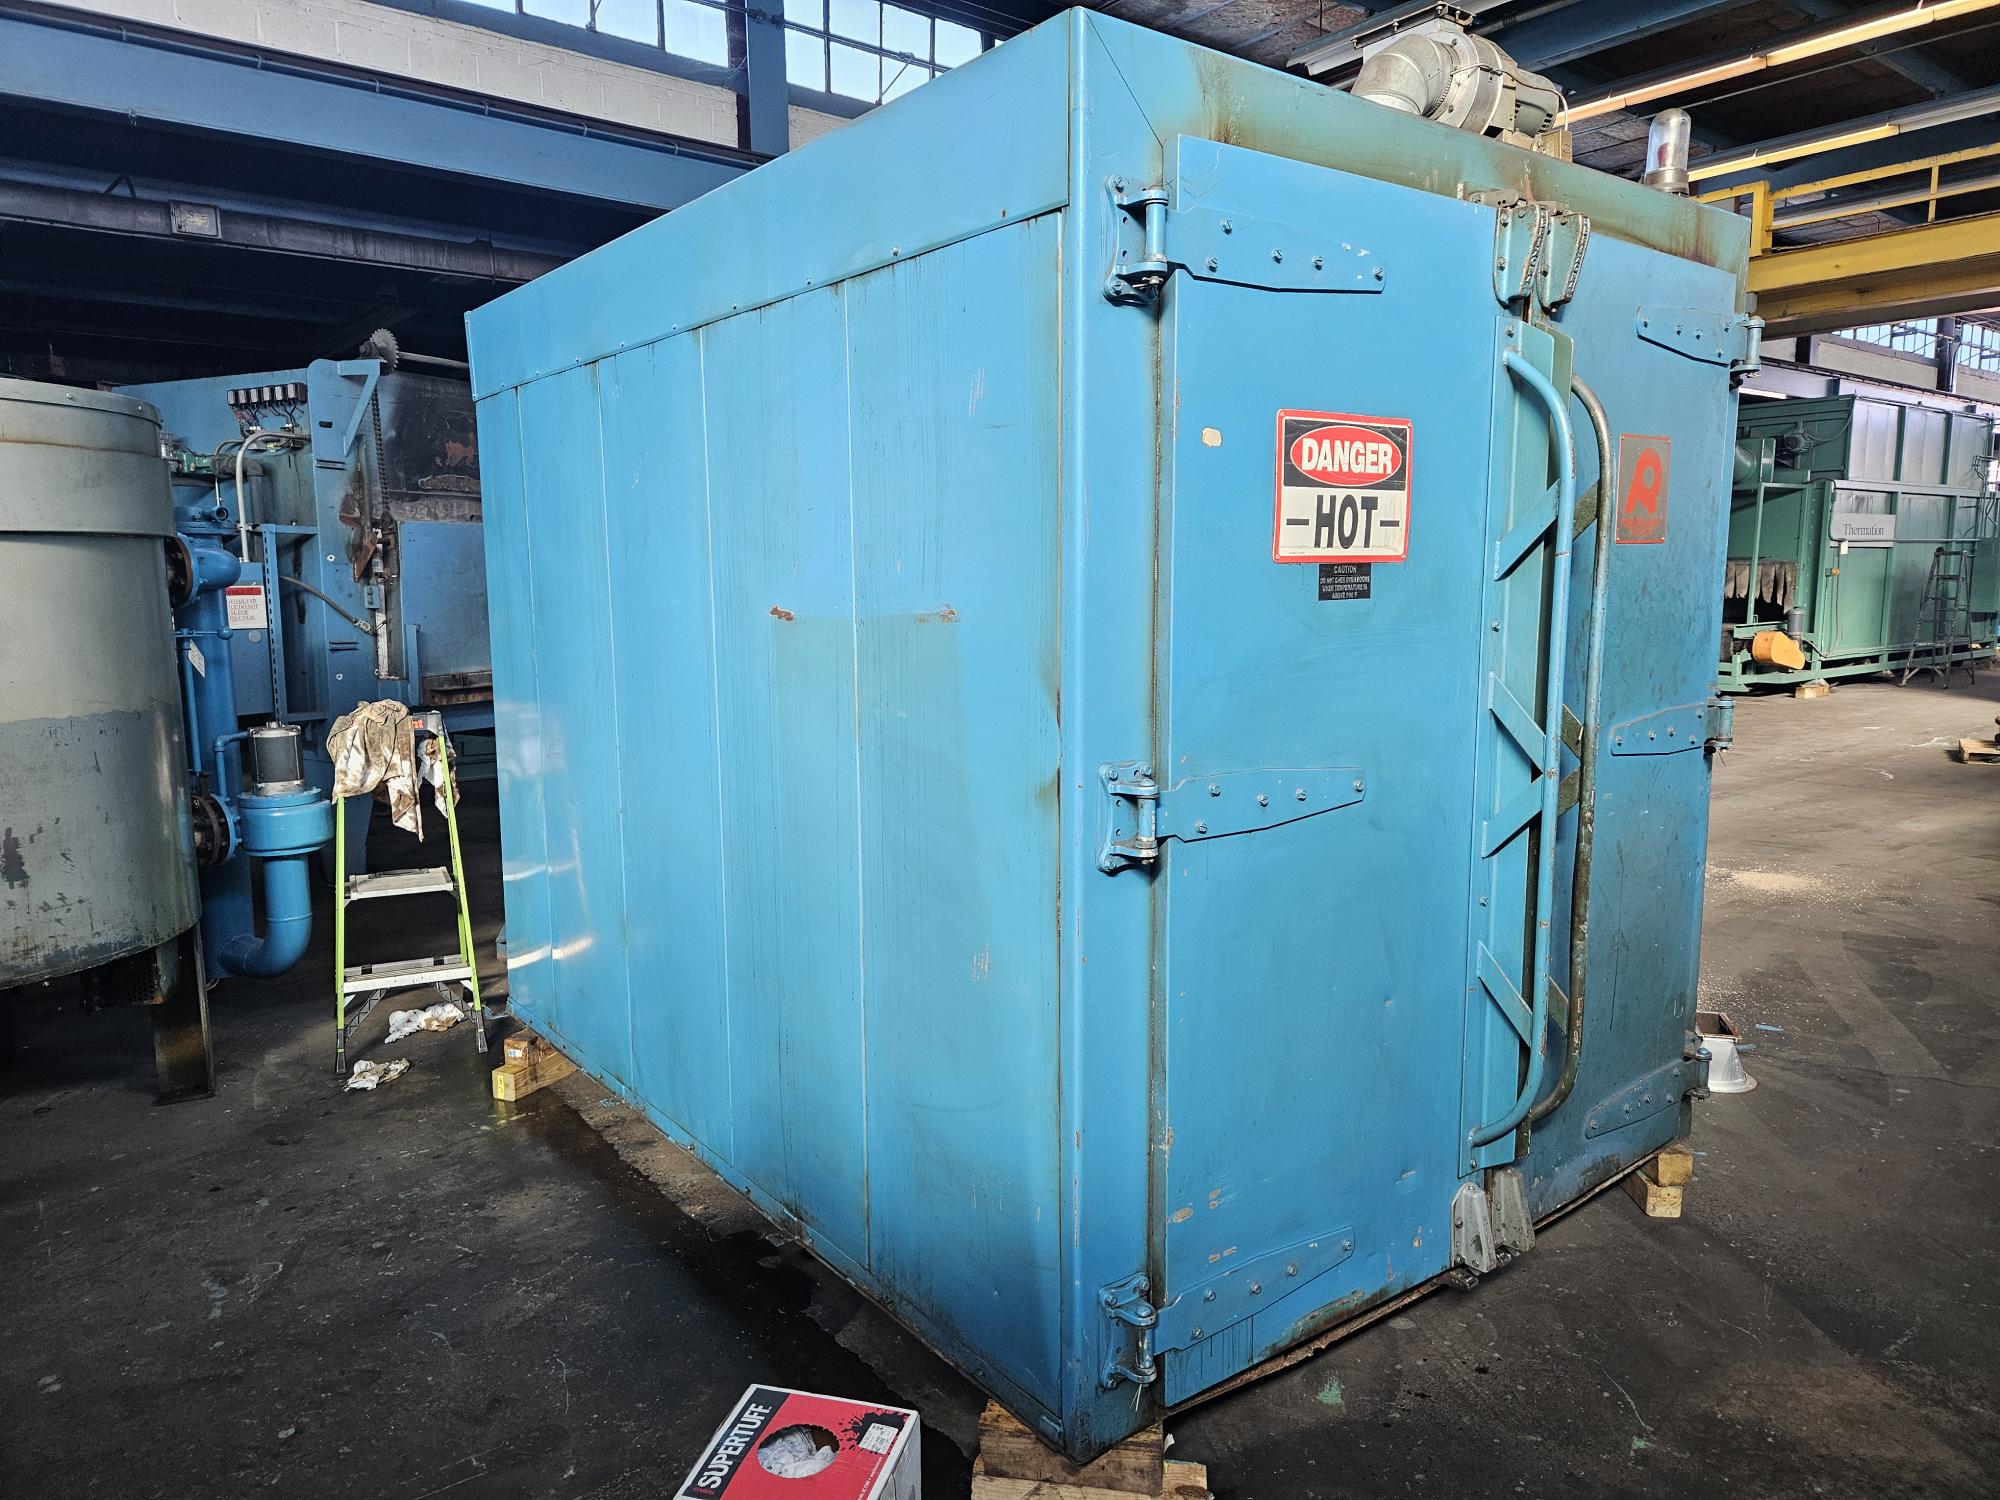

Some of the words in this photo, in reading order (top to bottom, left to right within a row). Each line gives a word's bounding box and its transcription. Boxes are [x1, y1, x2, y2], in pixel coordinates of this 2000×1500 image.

[1301, 438, 1393, 474] DANGER
[1843, 523, 1884, 536] Thermation
[1333, 565, 1357, 574] CAUTION
